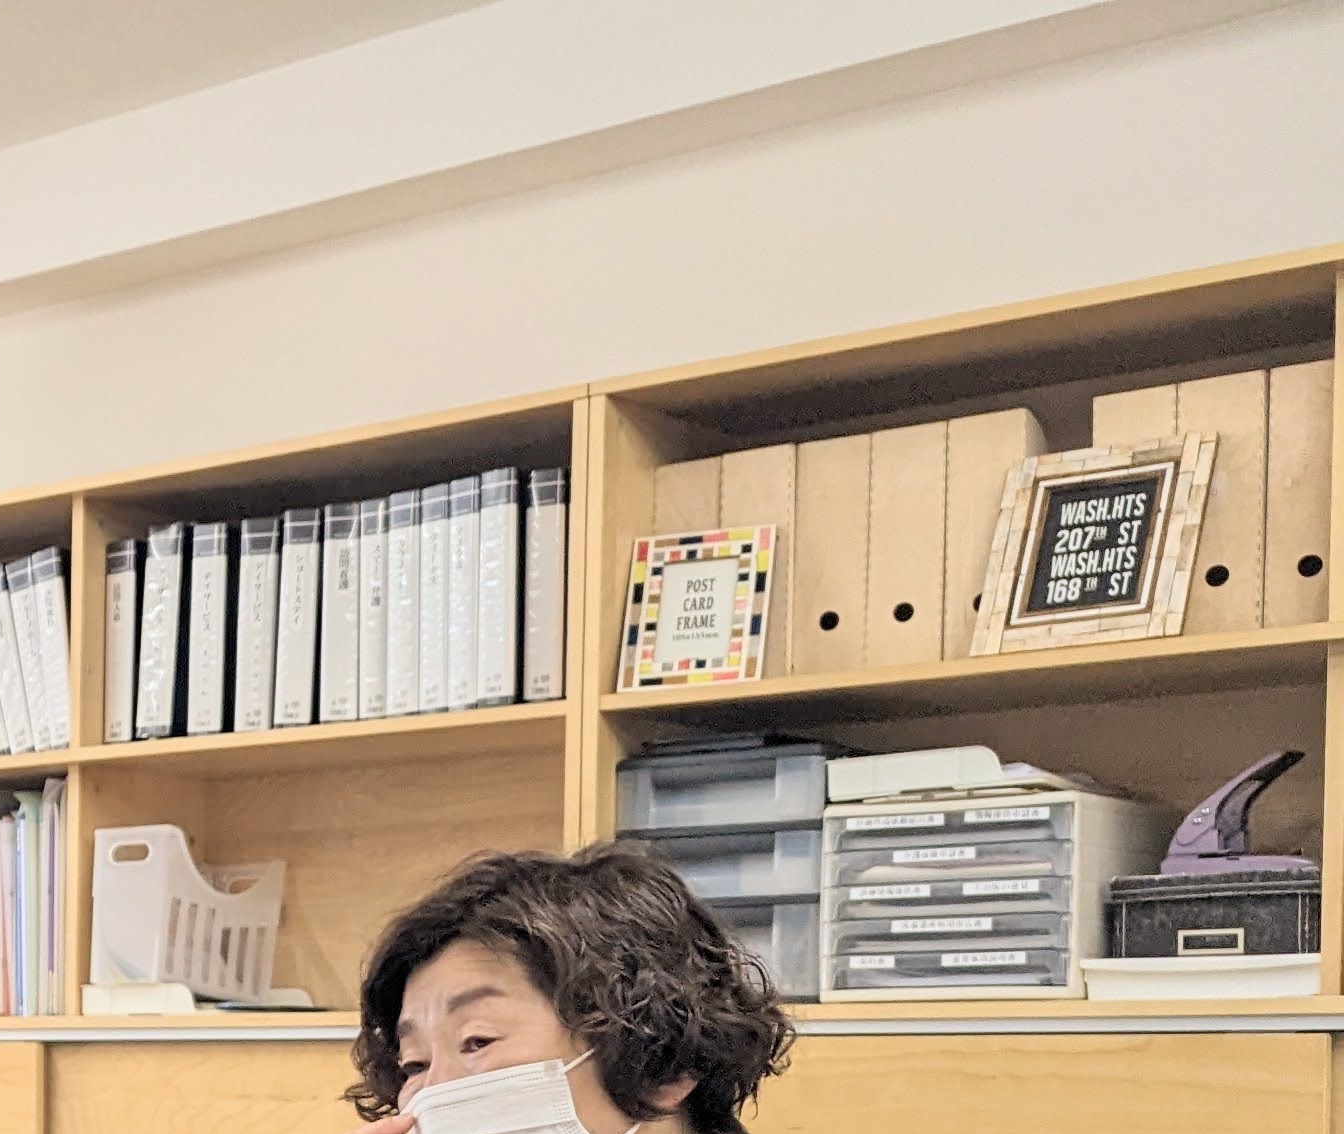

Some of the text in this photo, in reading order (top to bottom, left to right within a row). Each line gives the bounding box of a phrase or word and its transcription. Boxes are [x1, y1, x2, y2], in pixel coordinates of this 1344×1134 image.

[1061, 493, 1146, 526] WASH.HTS
[1118, 520, 1141, 545] ST
[1050, 546, 1137, 578] WASH.HTS
[687, 578, 716, 593] POST
[1108, 571, 1132, 596] ST
[683, 596, 714, 611] CARD
[676, 614, 716, 630] FRAME
